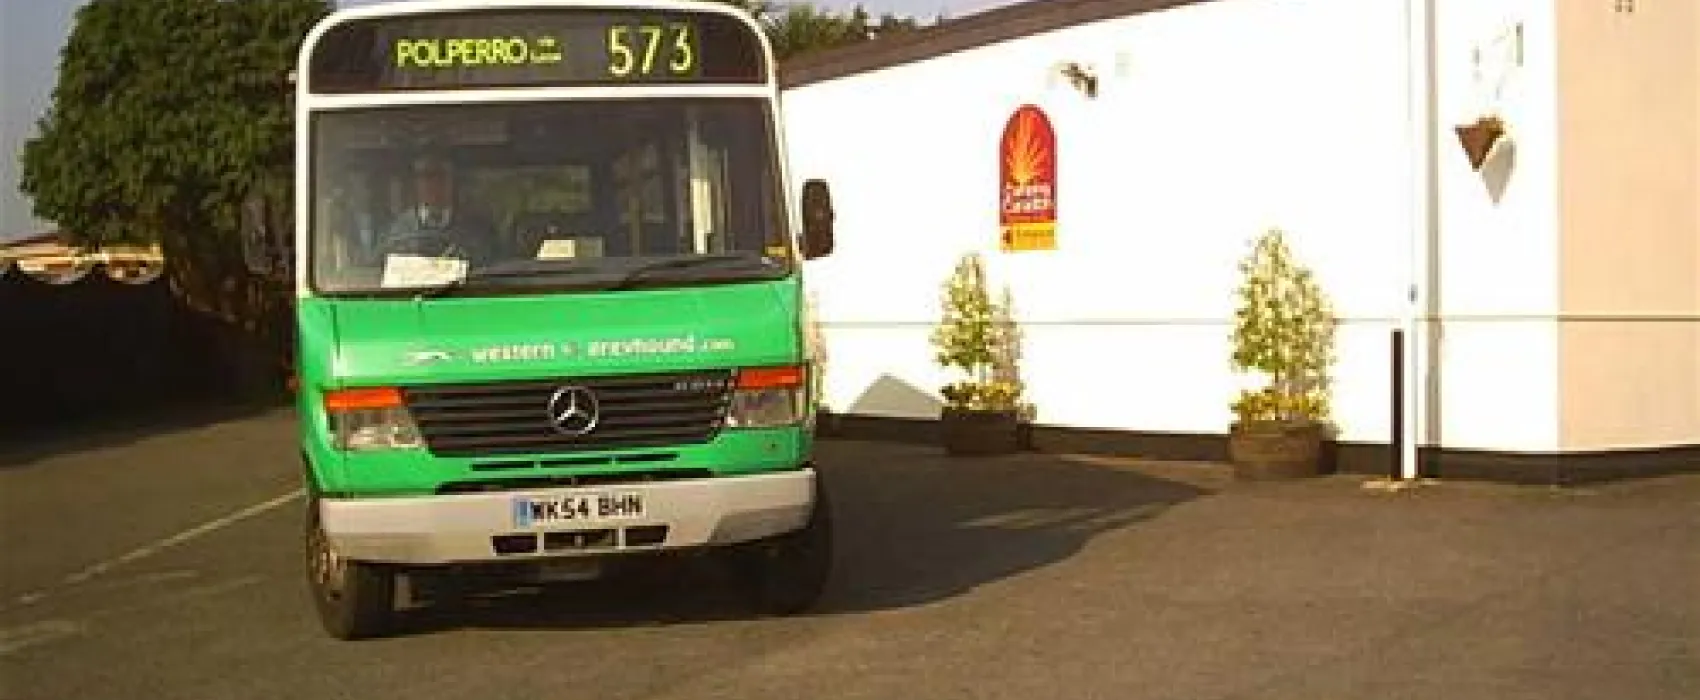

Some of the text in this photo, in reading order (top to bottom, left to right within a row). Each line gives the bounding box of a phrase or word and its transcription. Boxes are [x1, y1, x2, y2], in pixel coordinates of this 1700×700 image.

[397, 37, 528, 66] POLPERRO
[609, 24, 692, 75] 573
[530, 495, 643, 520] WK54 BHN
